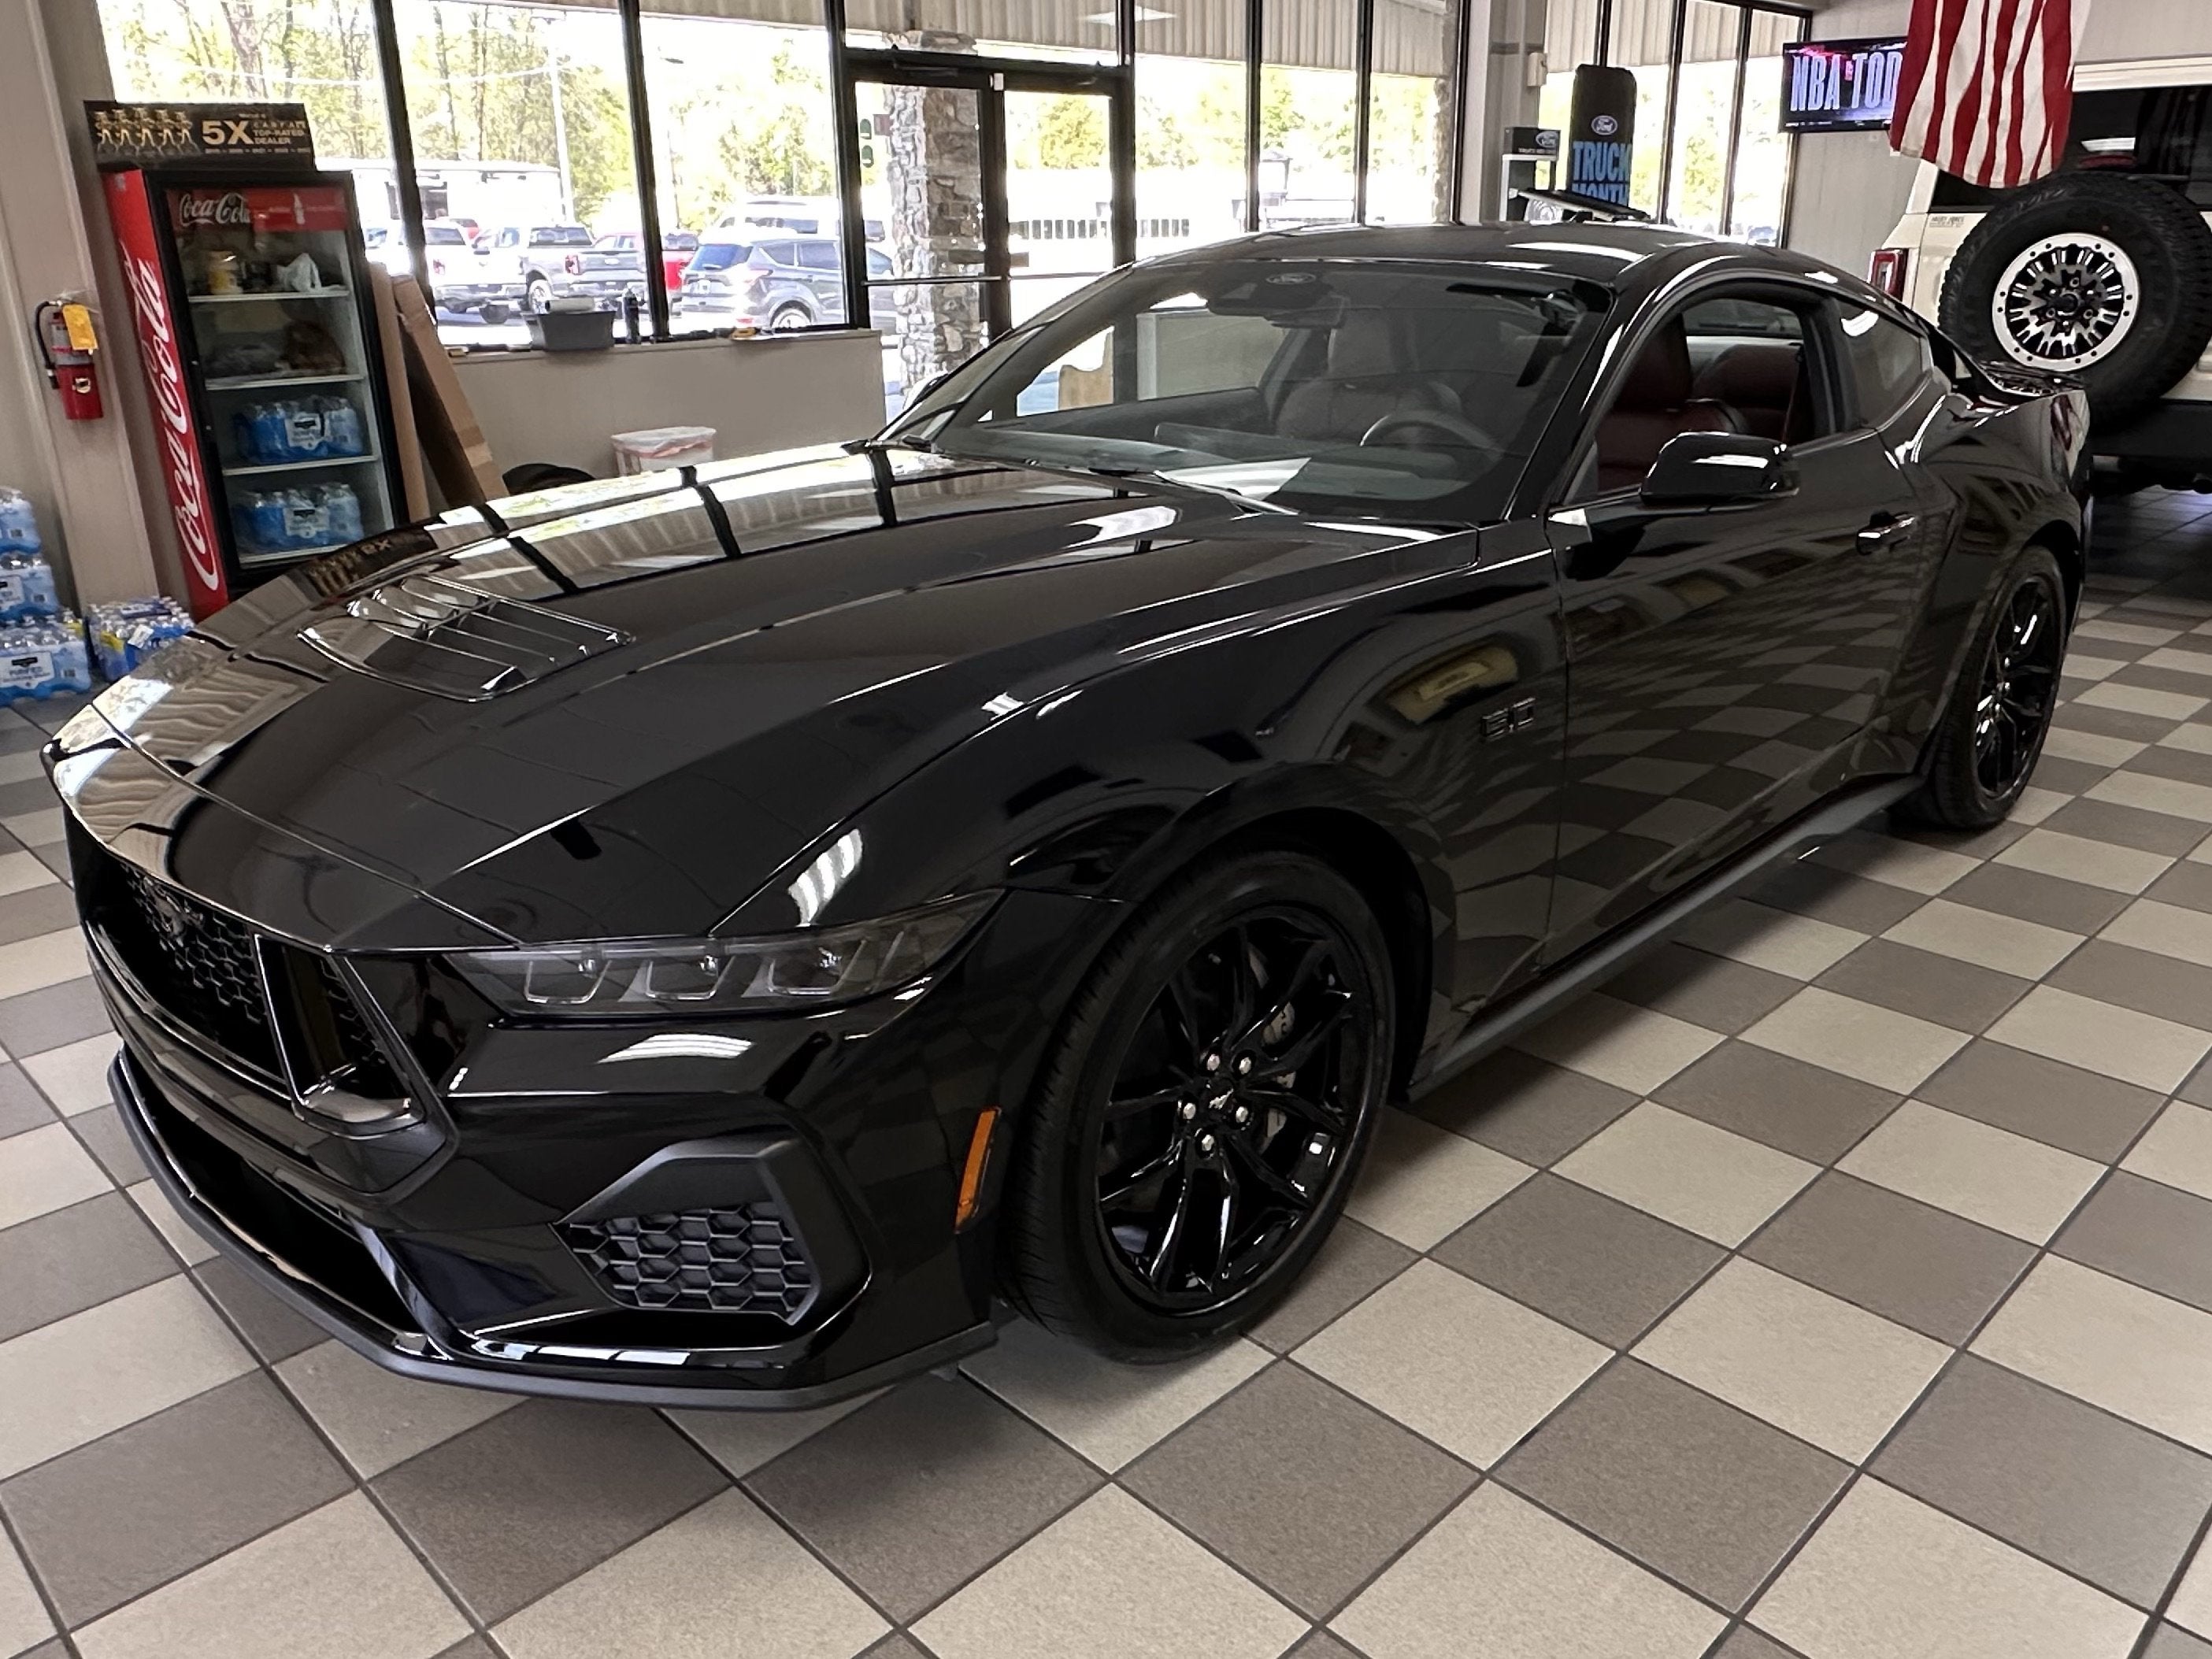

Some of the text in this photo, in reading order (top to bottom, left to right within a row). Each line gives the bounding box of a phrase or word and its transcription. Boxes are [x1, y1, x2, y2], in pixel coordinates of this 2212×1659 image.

[1790, 54, 1841, 112] NBA
[202, 120, 254, 145] 5X
[1573, 141, 1632, 182] TRUCK
[180, 193, 251, 227] Coca-Cola
[118, 238, 219, 591] Coca-Cola
